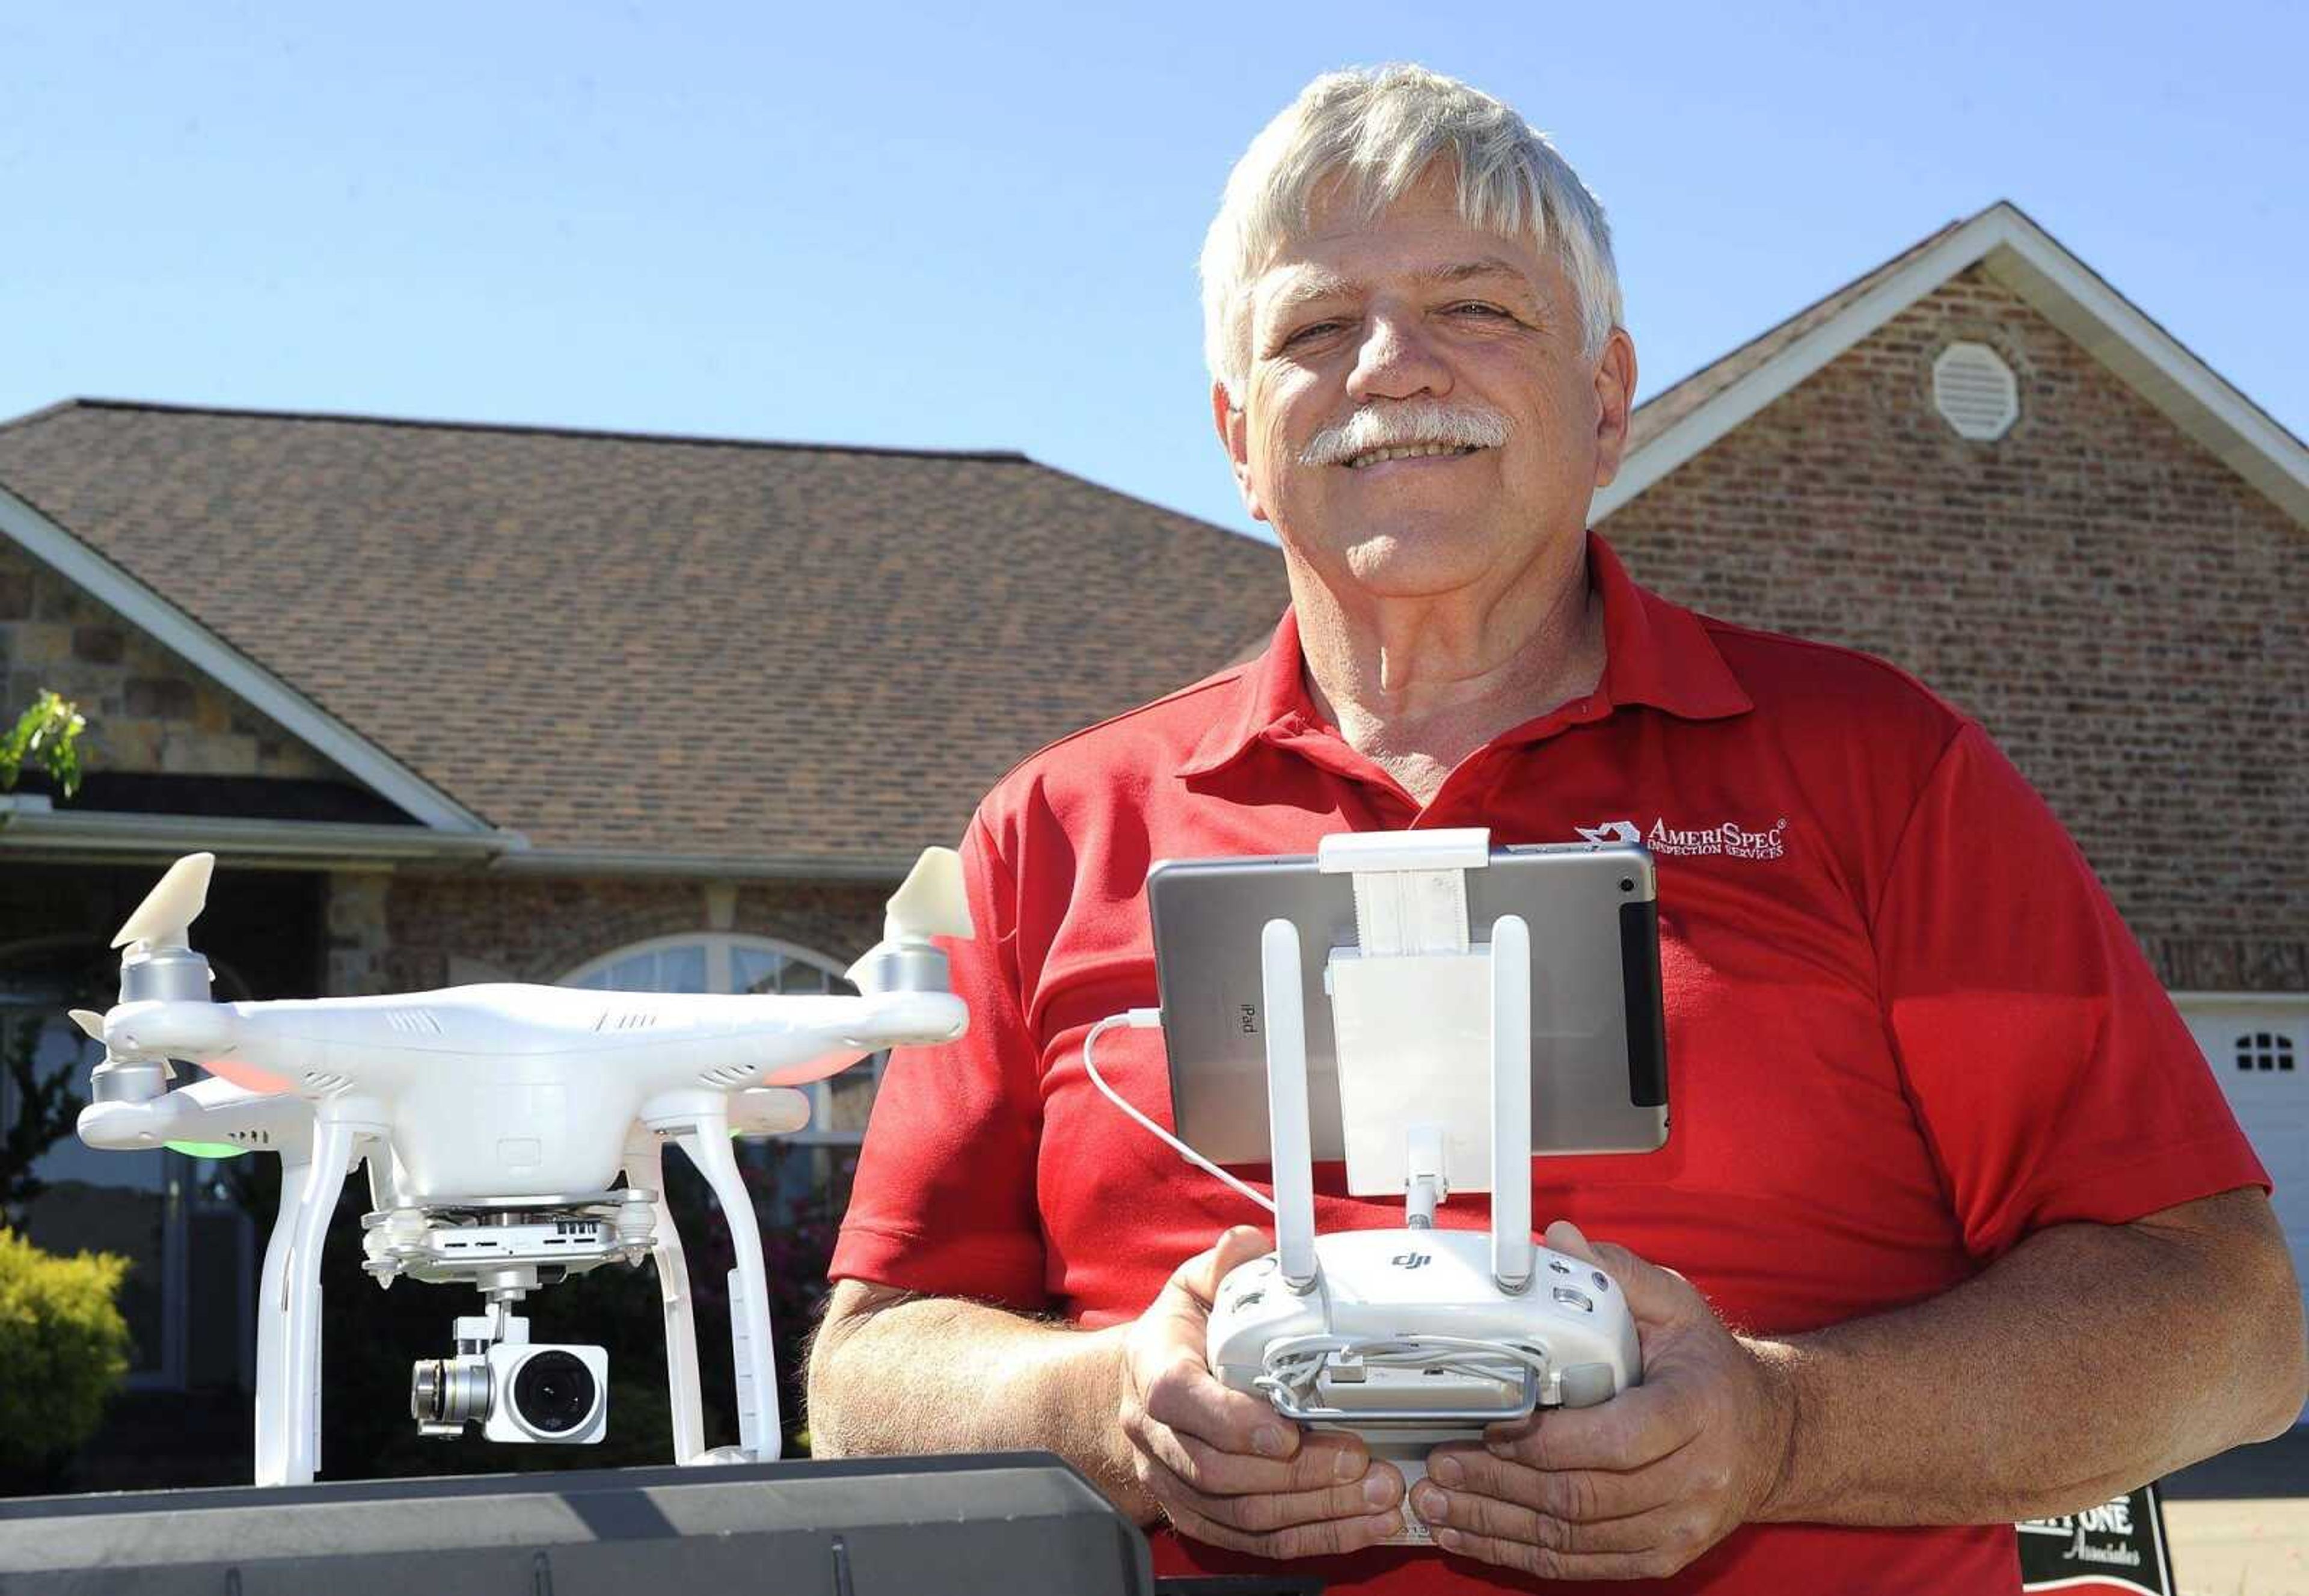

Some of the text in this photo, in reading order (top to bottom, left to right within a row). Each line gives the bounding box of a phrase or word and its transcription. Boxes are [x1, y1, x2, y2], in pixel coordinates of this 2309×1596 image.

[1648, 839, 1784, 859] INSPECTION SERVICES
[1241, 1004, 1259, 1033] iPad
[2078, 1503, 2134, 1535] ONE
